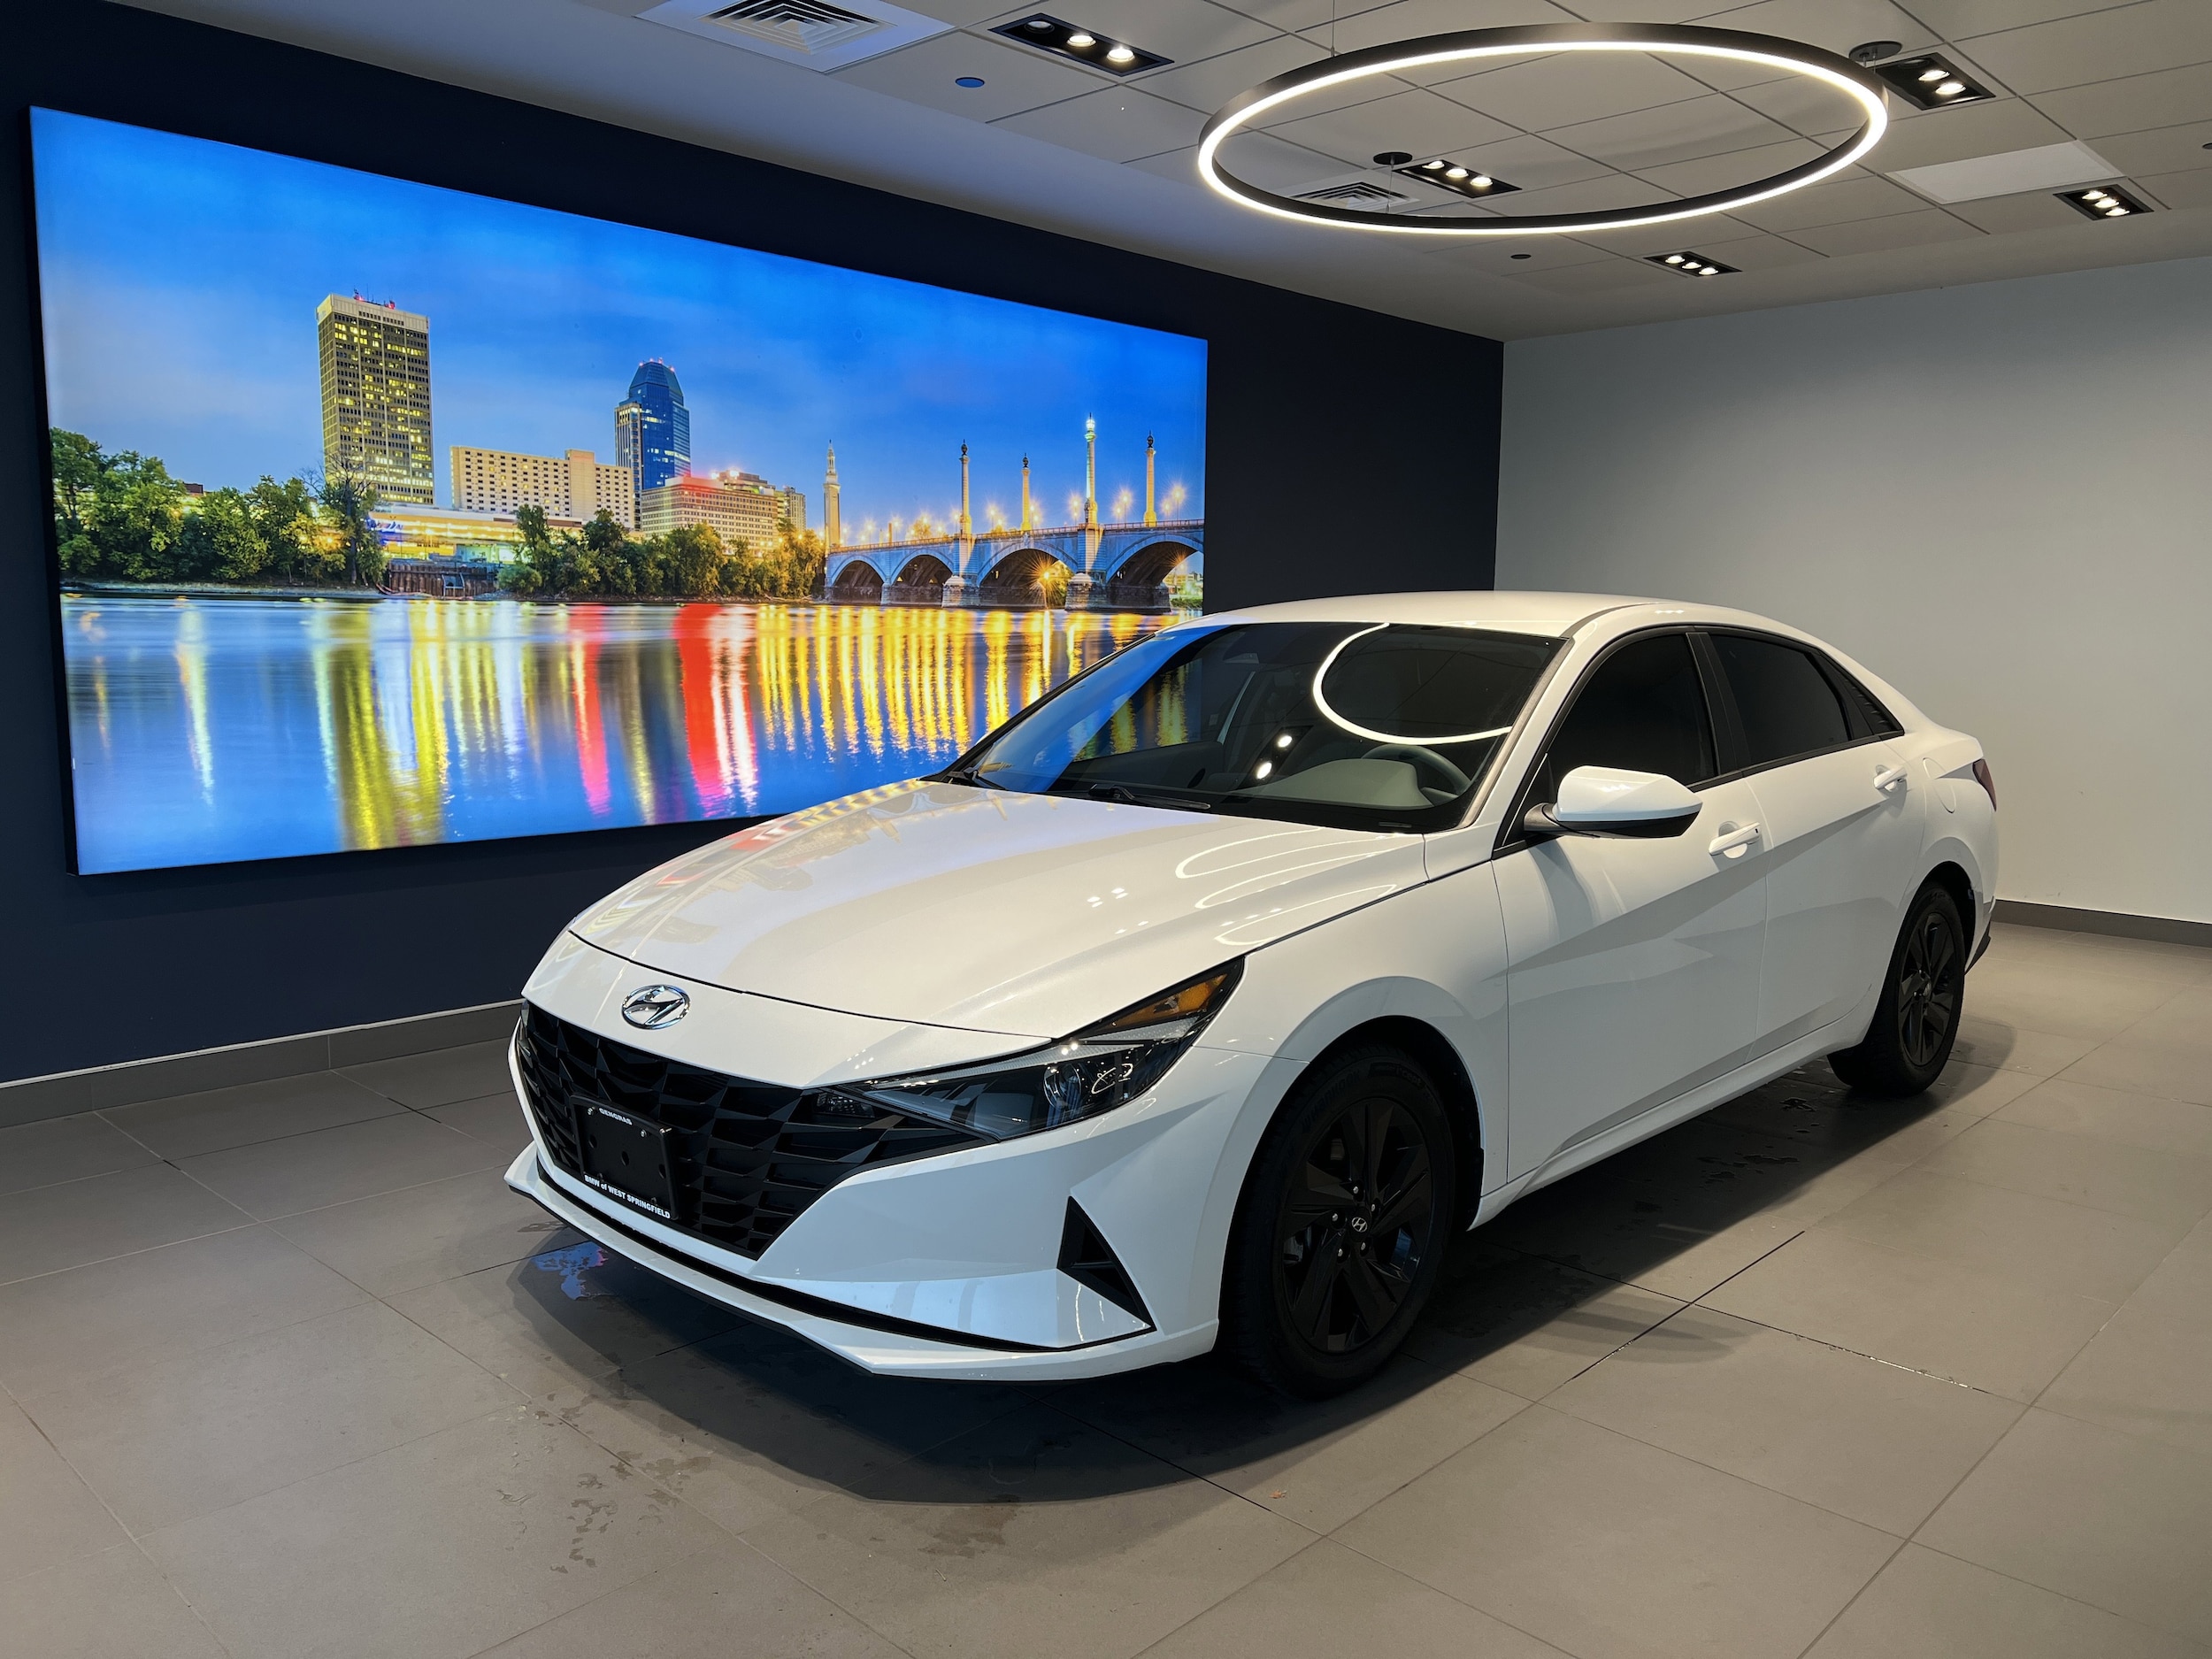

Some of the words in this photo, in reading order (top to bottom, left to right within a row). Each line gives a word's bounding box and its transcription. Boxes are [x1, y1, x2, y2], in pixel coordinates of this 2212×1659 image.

[599, 1108, 633, 1125] GENGRAS
[584, 1174, 600, 1187] BMW
[608, 1185, 626, 1200] WEST
[626, 1194, 671, 1219] SPRINGFIELD
